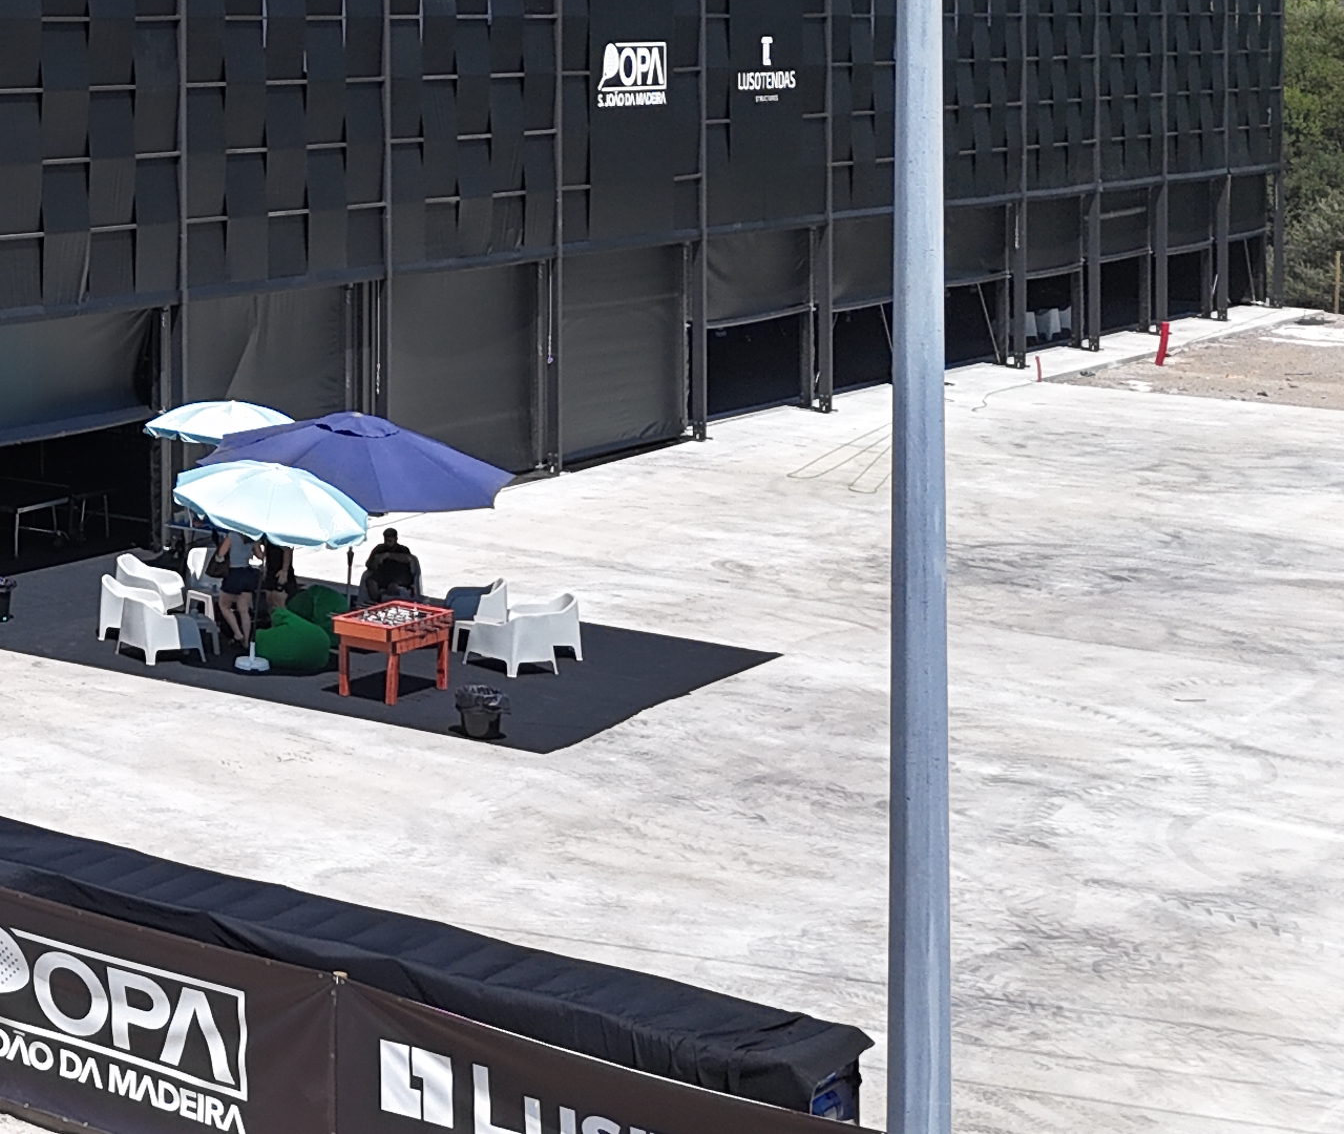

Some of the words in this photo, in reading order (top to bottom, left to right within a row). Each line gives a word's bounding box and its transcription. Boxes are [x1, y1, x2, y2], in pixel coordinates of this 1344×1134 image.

[737, 70, 796, 91] LUSOTENDAS
[60, 1049, 103, 1090] DA
[108, 1063, 246, 1134] MADEIRA
